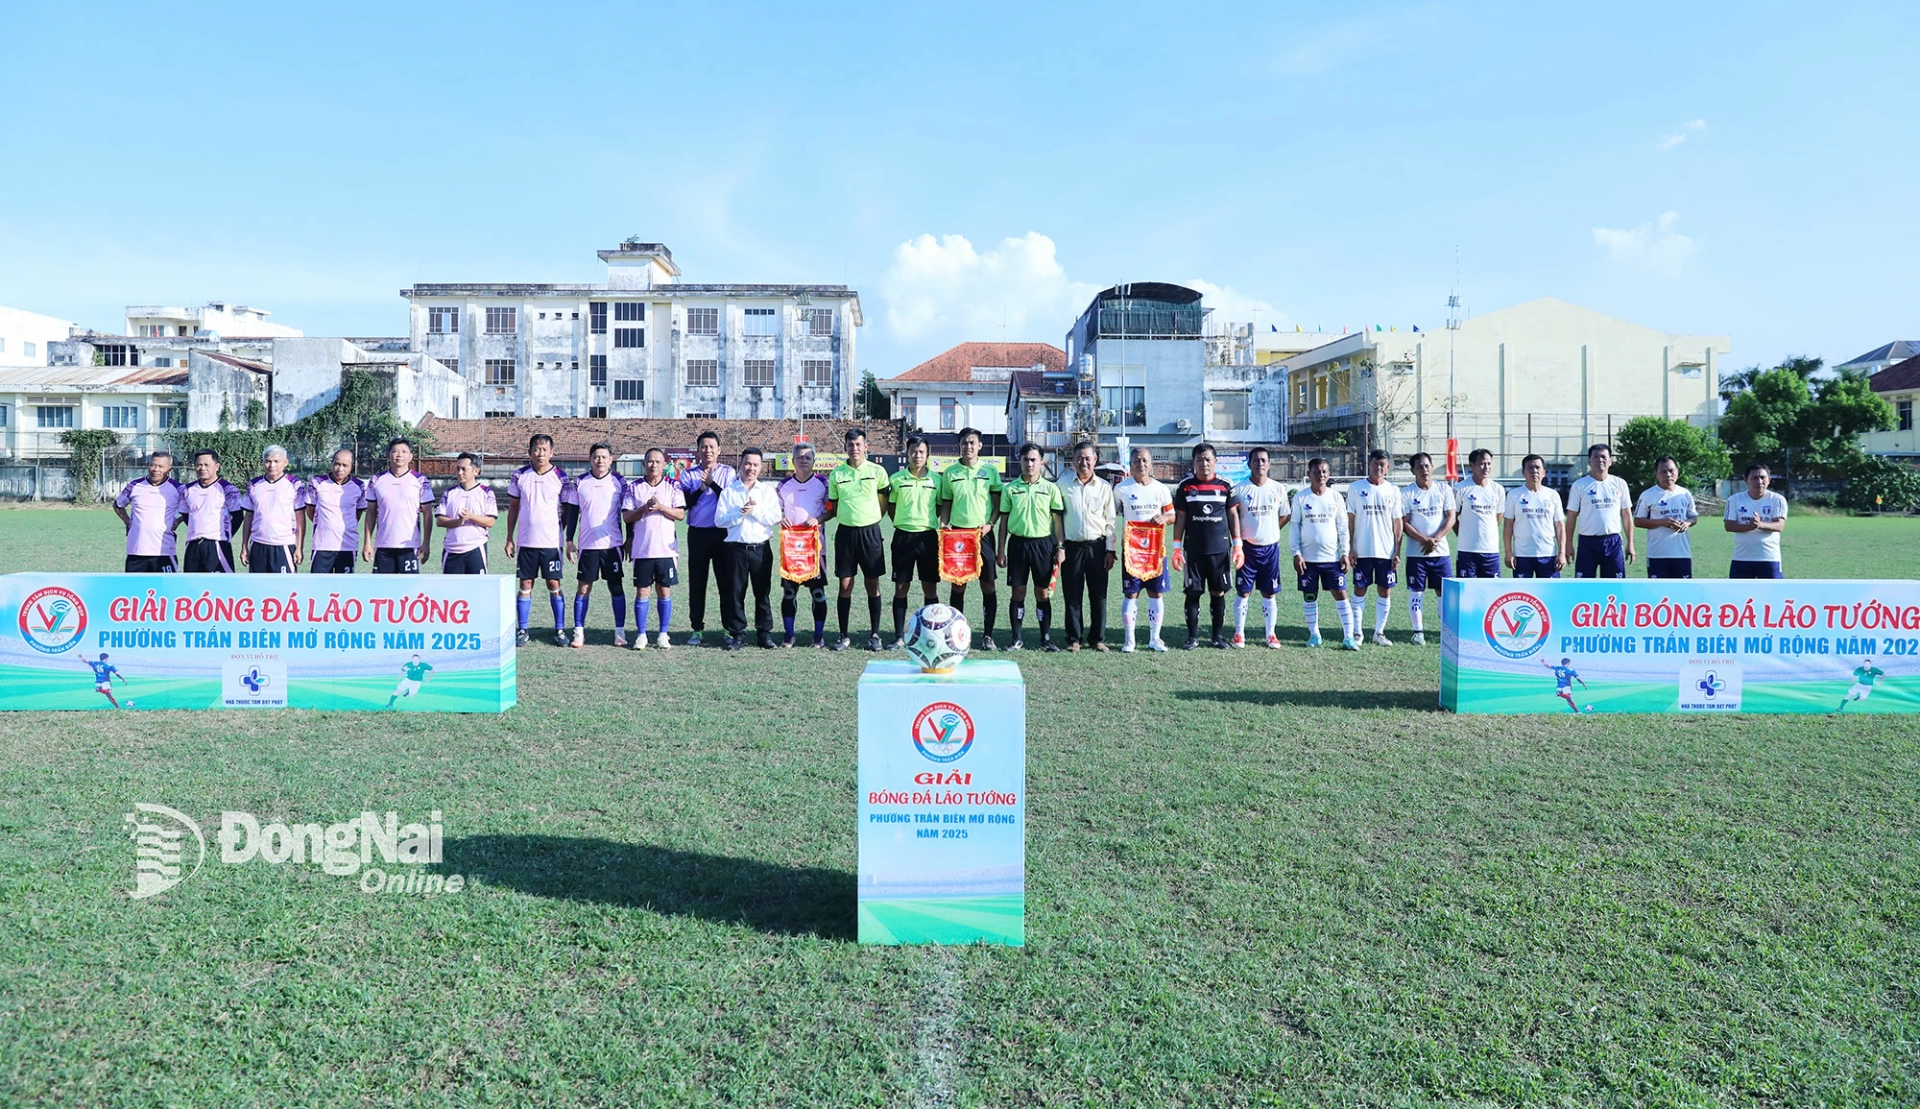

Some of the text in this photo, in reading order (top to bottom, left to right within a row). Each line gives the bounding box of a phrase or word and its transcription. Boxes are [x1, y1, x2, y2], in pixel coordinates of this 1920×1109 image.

[405, 560, 417, 571] 23
[549, 560, 561, 572] 20
[613, 562, 619, 572] 3
[1338, 576, 1344, 586] 8
[1386, 572, 1396, 584] 20
[109, 589, 470, 624] GIẢI BÓNG ĐÁ LÃO TƯỚNG
[1572, 596, 1920, 630] GIẢI BÓNG ĐÁ LÃO TƯỚNG
[98, 625, 481, 652] PHƯỜNG TRẤN BIÊN MỞ RỘNG NĂM 2025
[1561, 634, 1636, 653] PHƯỜNG
[1643, 631, 1689, 653] TRẤN
[1697, 634, 1737, 653] BIÊN
[1744, 633, 1773, 654] MỞ
[1780, 635, 1829, 657] RỘNG
[1836, 635, 1876, 655] NĂM
[914, 769, 971, 785] GIẢI
[869, 789, 1016, 805] BÓNG ĐÁ LÃO TƯỚNG
[870, 812, 910, 823] PHƯỜNG
[943, 812, 965, 824] BIÊN
[988, 813, 1015, 825] RỘNG
[942, 829, 968, 838] 2025
